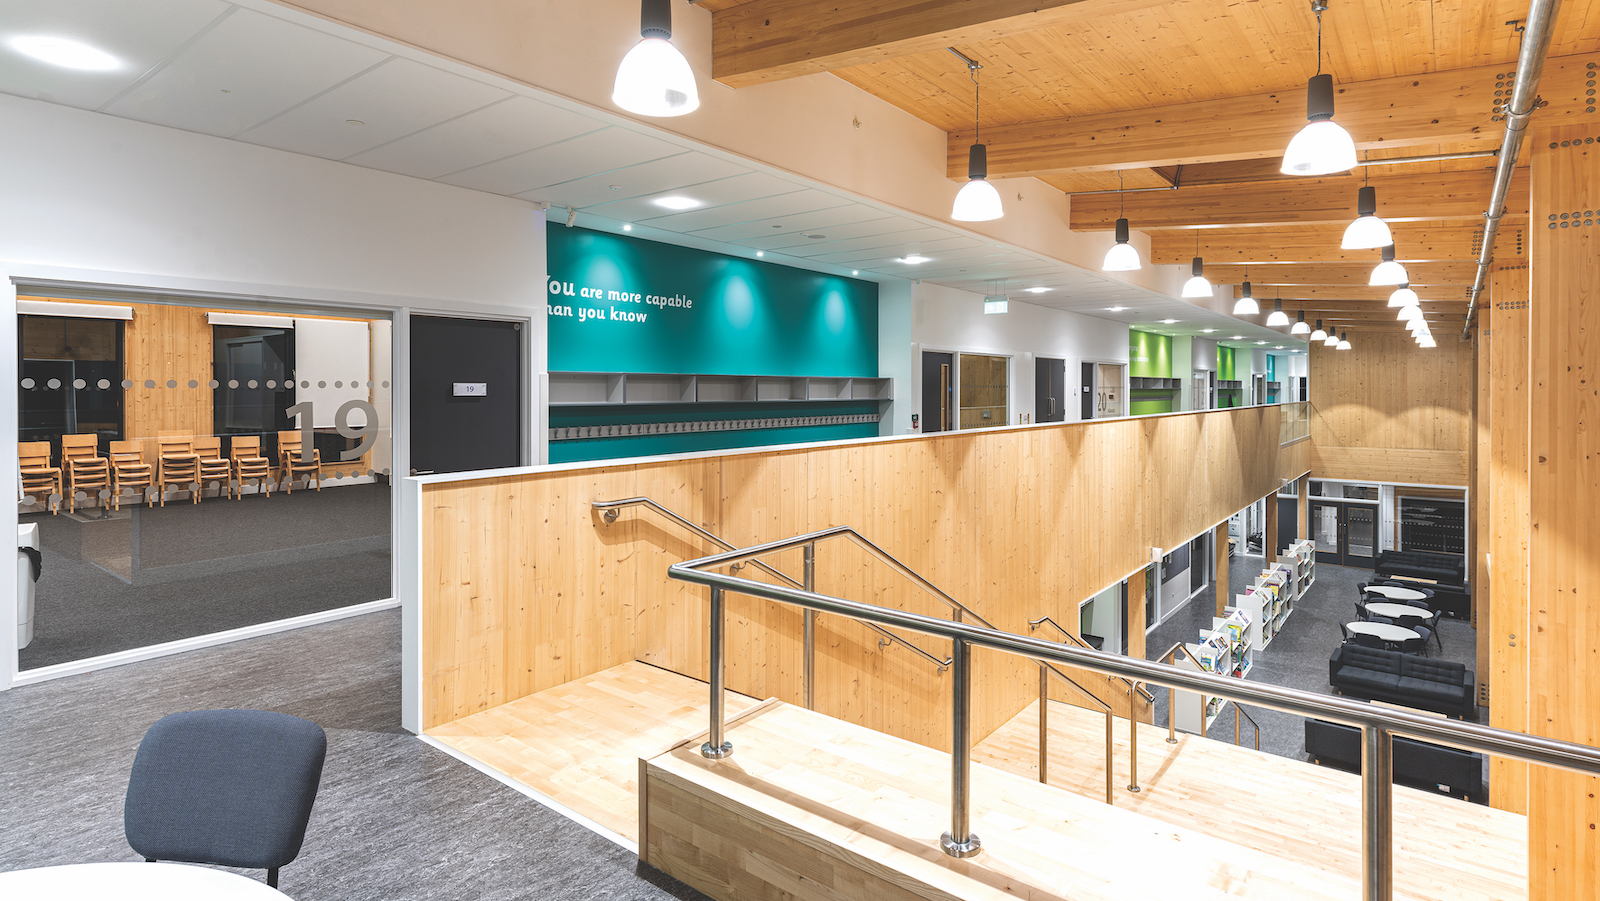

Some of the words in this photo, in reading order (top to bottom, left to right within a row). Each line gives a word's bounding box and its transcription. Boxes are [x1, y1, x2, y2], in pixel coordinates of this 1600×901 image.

[580, 287, 603, 299] are
[608, 290, 641, 303] more
[646, 294, 692, 309] capable
[578, 307, 606, 322] you
[610, 305, 647, 323] know
[466, 385, 474, 393] 19
[285, 399, 379, 463] 19
